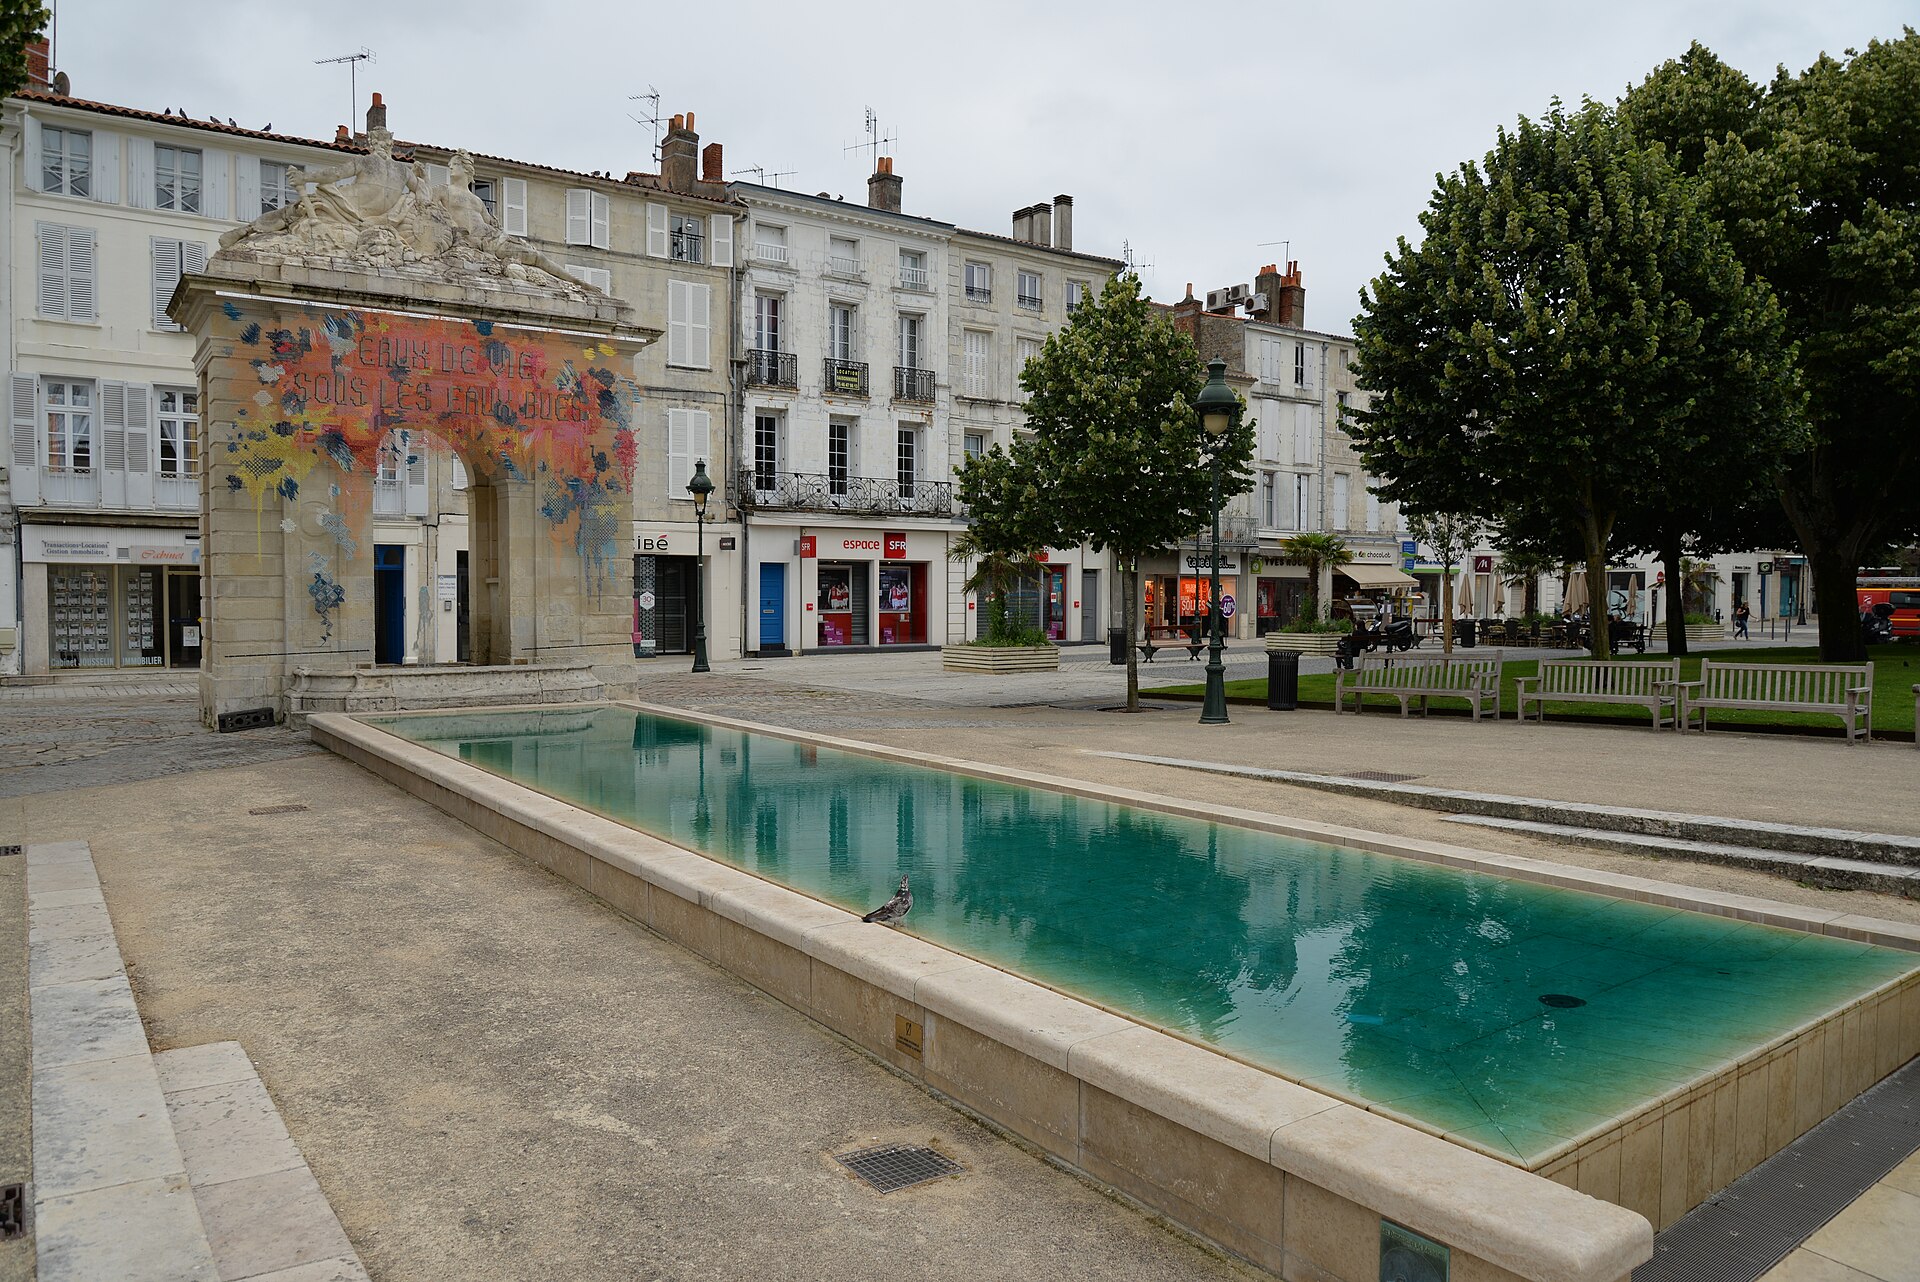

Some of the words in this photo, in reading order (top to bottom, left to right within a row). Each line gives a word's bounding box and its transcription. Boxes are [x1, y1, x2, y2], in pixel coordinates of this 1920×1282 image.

[359, 335, 430, 369] EAUX
[441, 342, 477, 375] DE
[490, 350, 533, 380] VIE
[294, 372, 368, 406] SOUS
[380, 378, 432, 411] LES
[448, 385, 512, 418] EAUX
[524, 391, 590, 422] BUES
[801, 543, 811, 551] SFR
[843, 540, 880, 550] espace
[889, 540, 907, 550] SFR
[141, 550, 184, 560] Cabinet
[1264, 557, 1284, 566] YVES
[122, 656, 162, 666] IMMOBILIER
